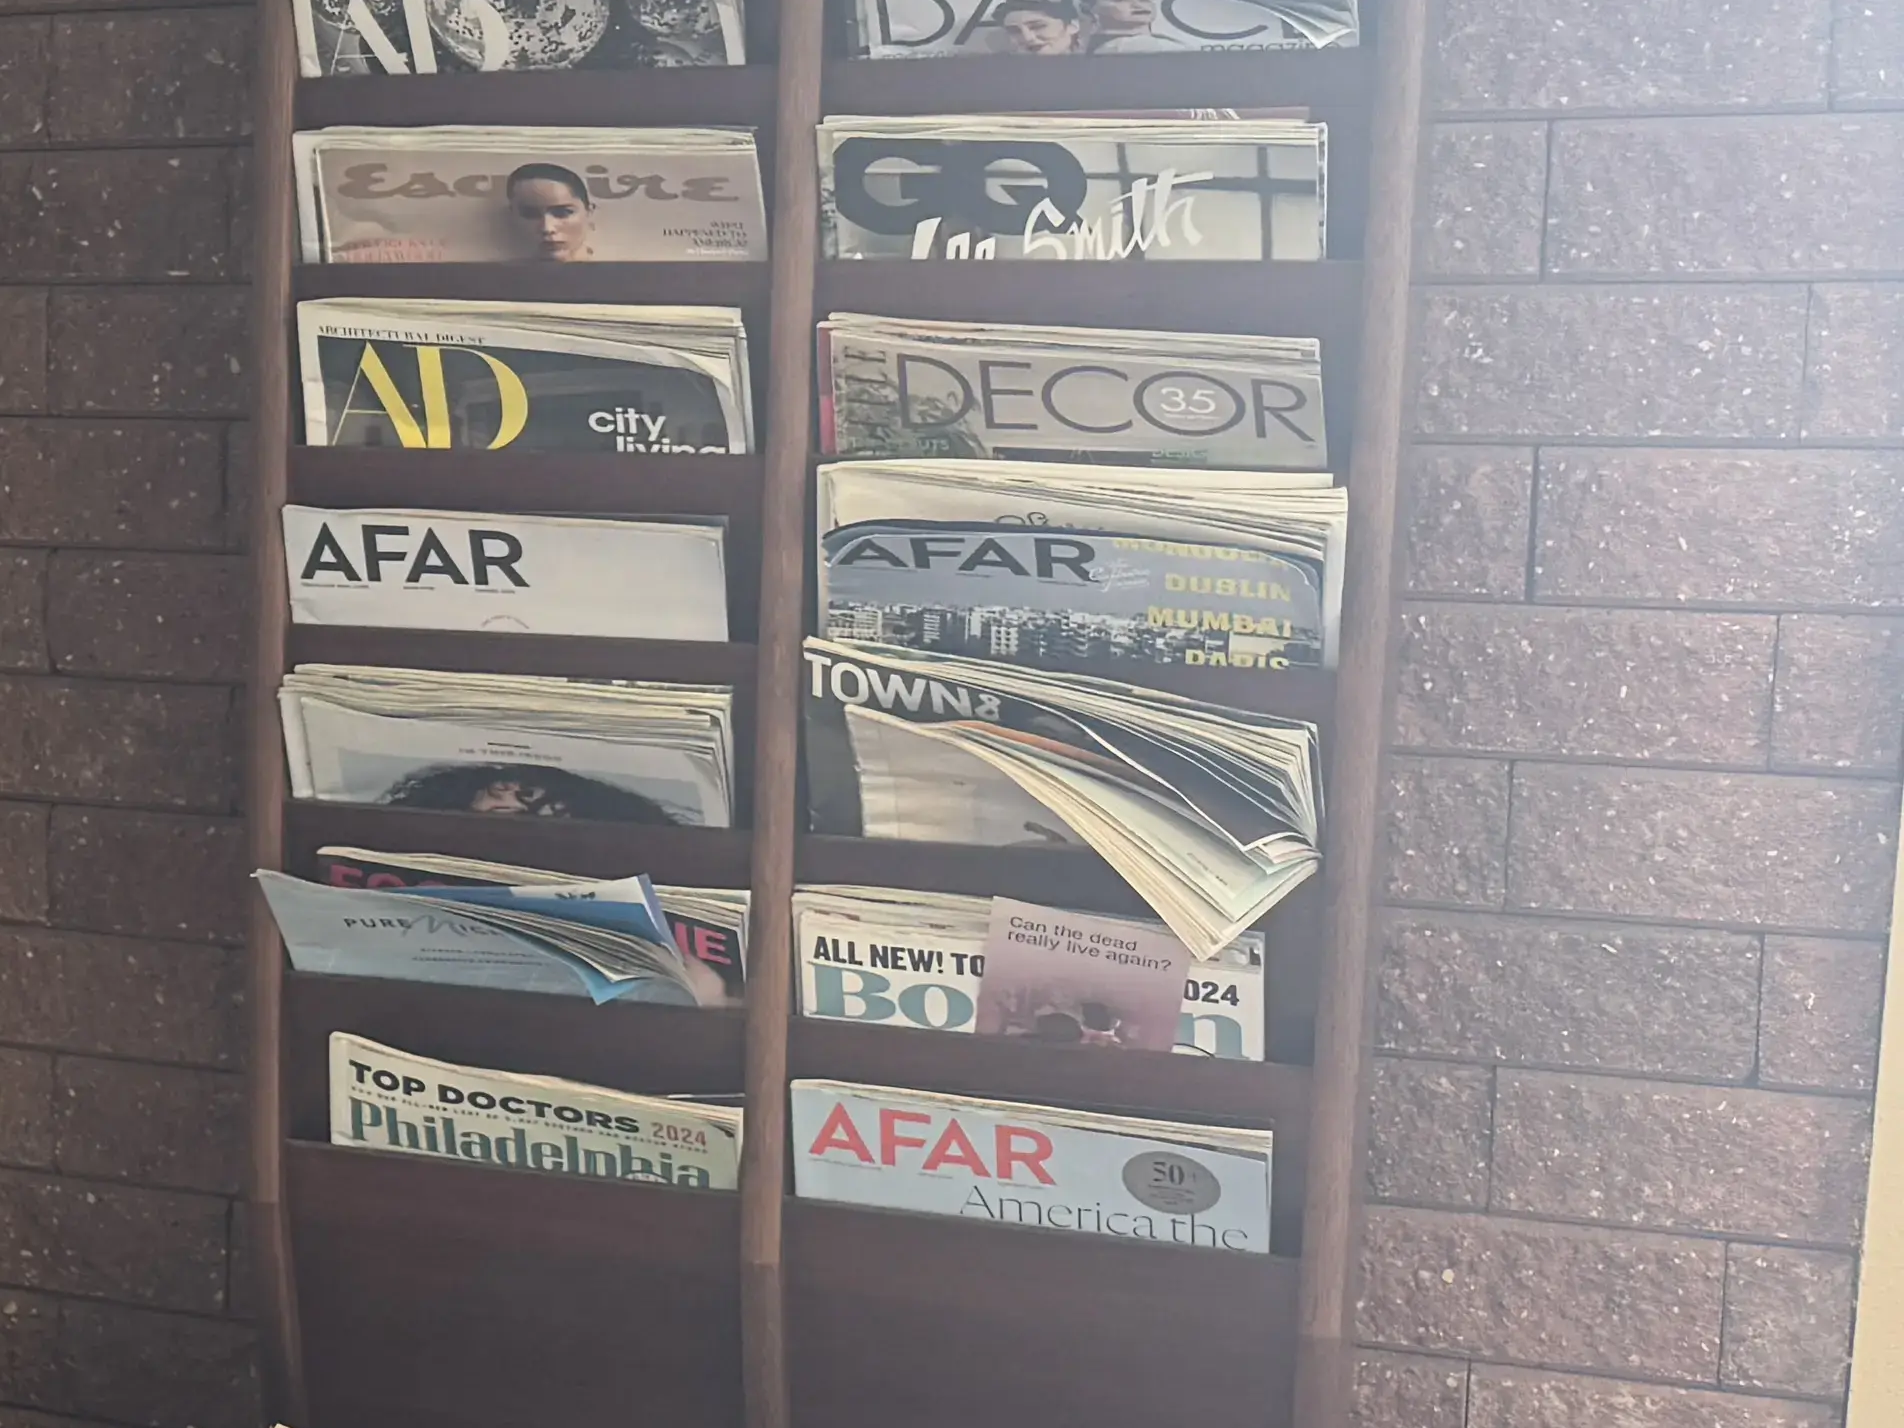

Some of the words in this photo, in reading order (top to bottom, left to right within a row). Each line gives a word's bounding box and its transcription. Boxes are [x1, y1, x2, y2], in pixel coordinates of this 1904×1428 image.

[834, 135, 1088, 235] GQ
[331, 341, 528, 450] AD
[896, 353, 1314, 442] DECOR
[1160, 386, 1217, 415] 35
[588, 407, 666, 442] city
[301, 522, 530, 588] AFAR
[838, 536, 1102, 585] AFAR
[1166, 573, 1291, 602] DUBLIN
[1147, 605, 1291, 637] MUMBAI
[804, 652, 971, 718] TOWN
[344, 916, 411, 929] PURE
[1006, 929, 1059, 953] really
[1066, 936, 1101, 956] live
[1106, 945, 1172, 973] again?
[1009, 915, 1050, 935] Can
[1055, 922, 1085, 943] the
[1090, 931, 1138, 953] dead
[813, 936, 863, 967] ALL
[870, 945, 945, 975] NEW!
[349, 1060, 425, 1096] TOP
[438, 1083, 640, 1134] DOCTORS
[651, 1122, 706, 1147] 2024
[349, 1096, 710, 1189] Philadelphia
[810, 1102, 1057, 1186] AFAR
[960, 1185, 1157, 1241] America
[1171, 1213, 1248, 1252] the
